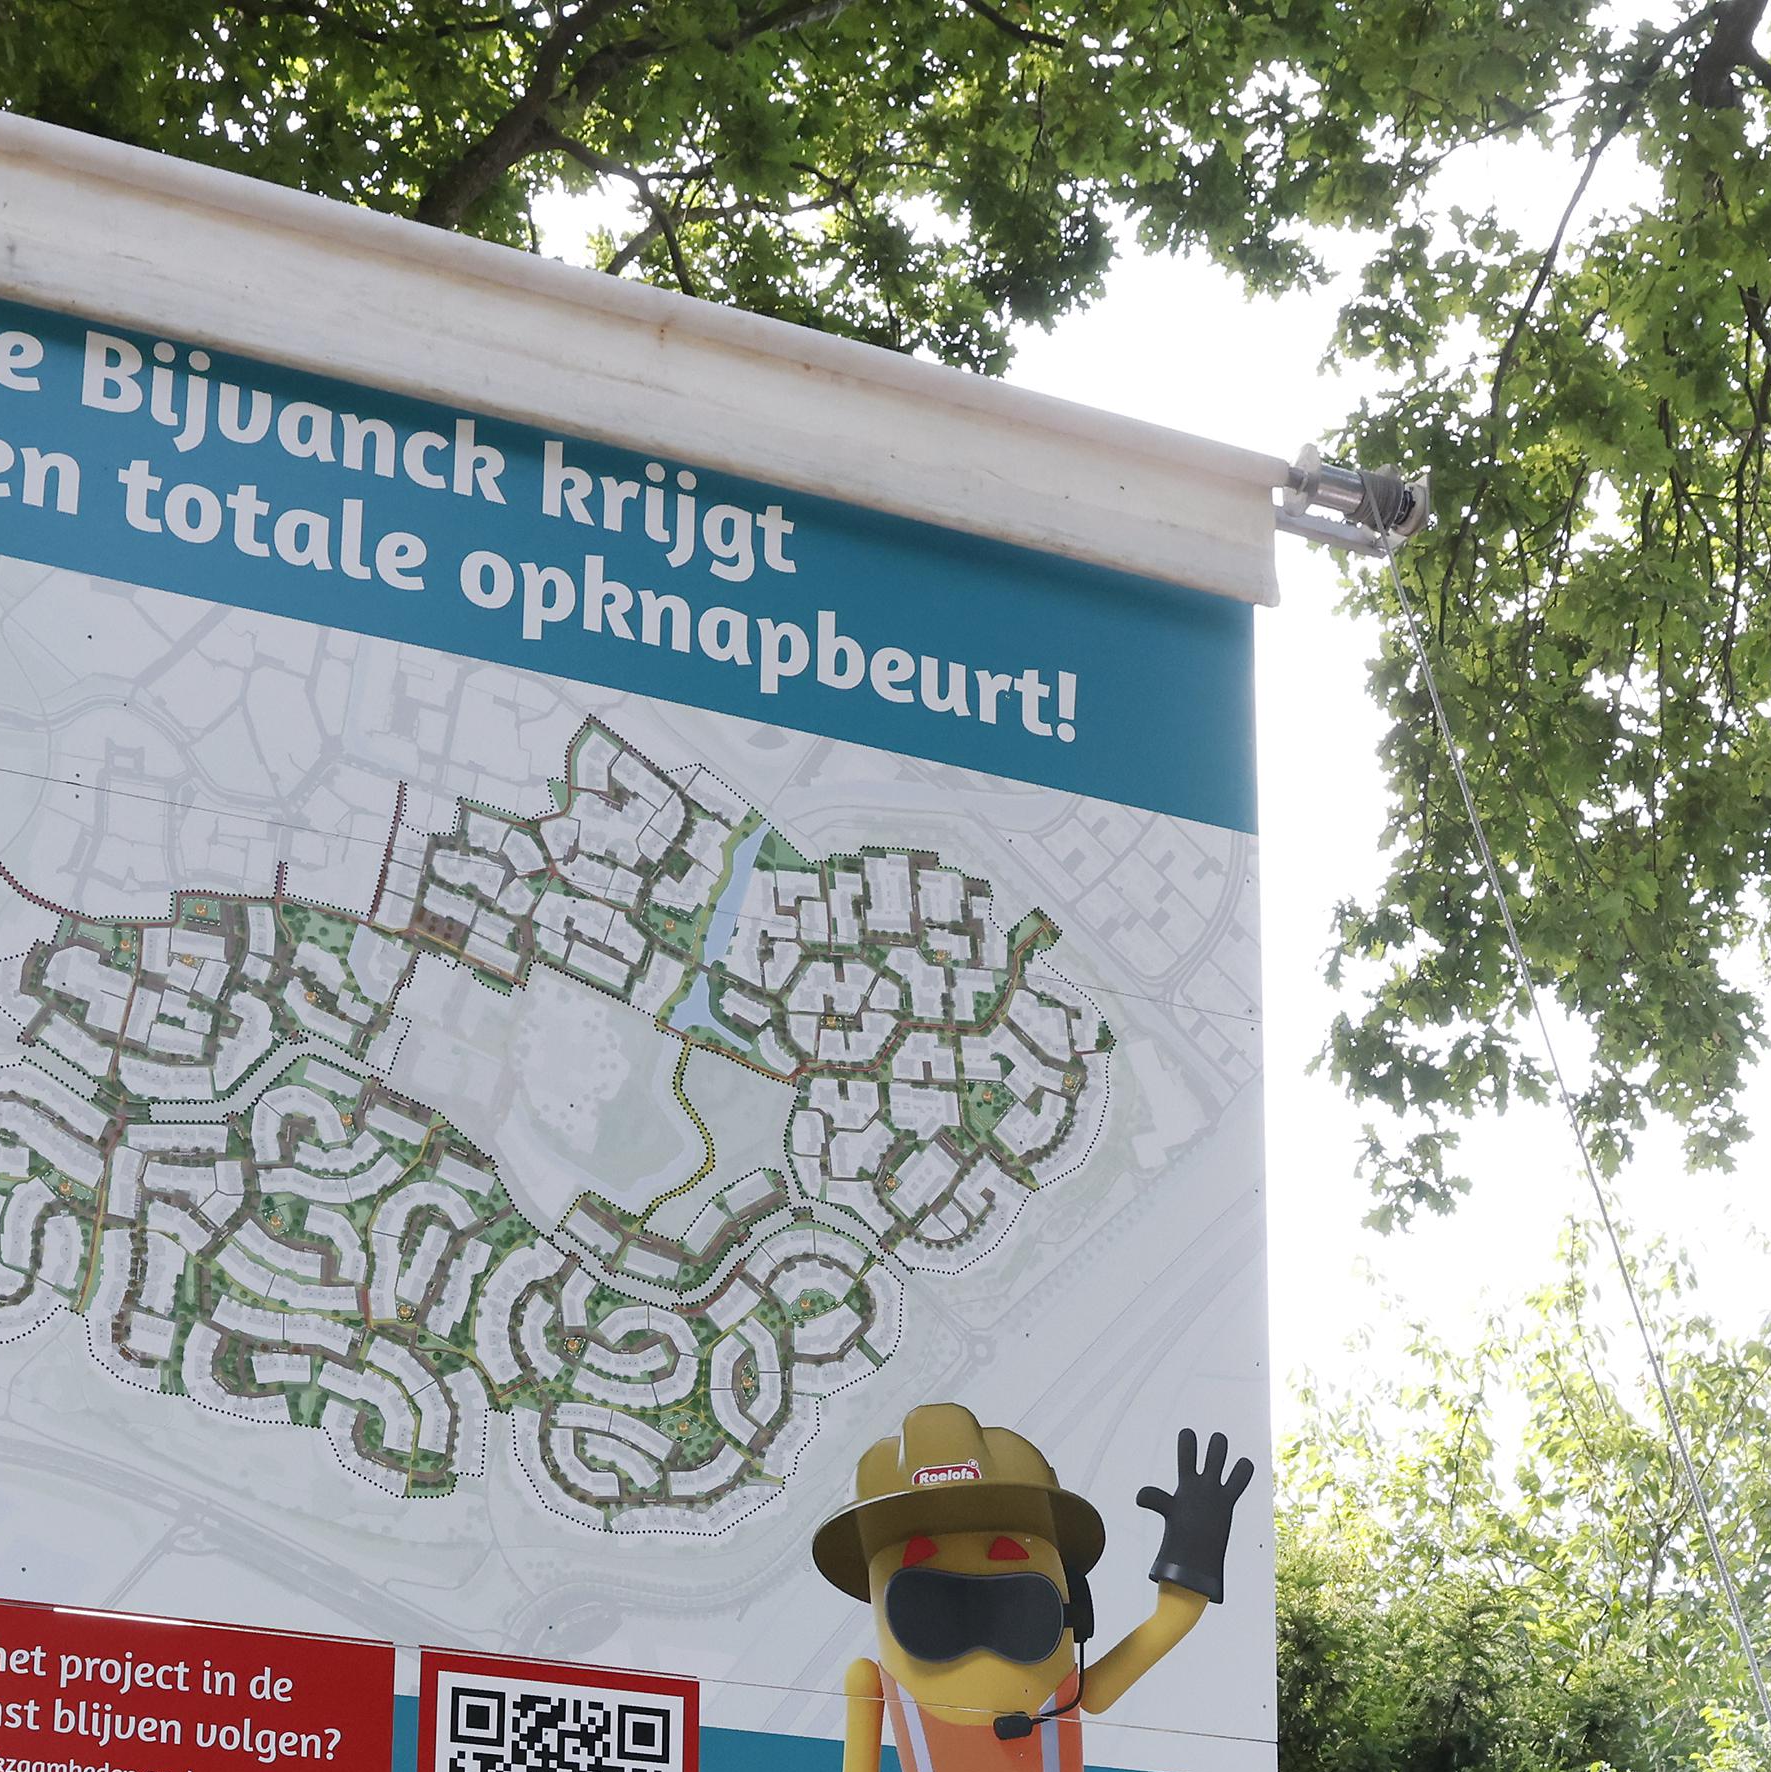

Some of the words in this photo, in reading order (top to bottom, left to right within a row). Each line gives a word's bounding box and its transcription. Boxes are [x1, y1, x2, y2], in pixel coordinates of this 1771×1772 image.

[81, 330, 507, 505] Bijvanck
[542, 440, 796, 582] krijgt
[118, 460, 428, 591] totale
[460, 550, 1078, 743] opknapbeurt!
[919, 1468, 975, 1484] Roelofs
[59, 1652, 190, 1695] project
[203, 1660, 236, 1697] in
[249, 1666, 293, 1702] de
[53, 1698, 182, 1747] blijven
[196, 1718, 342, 1764] volgen?
